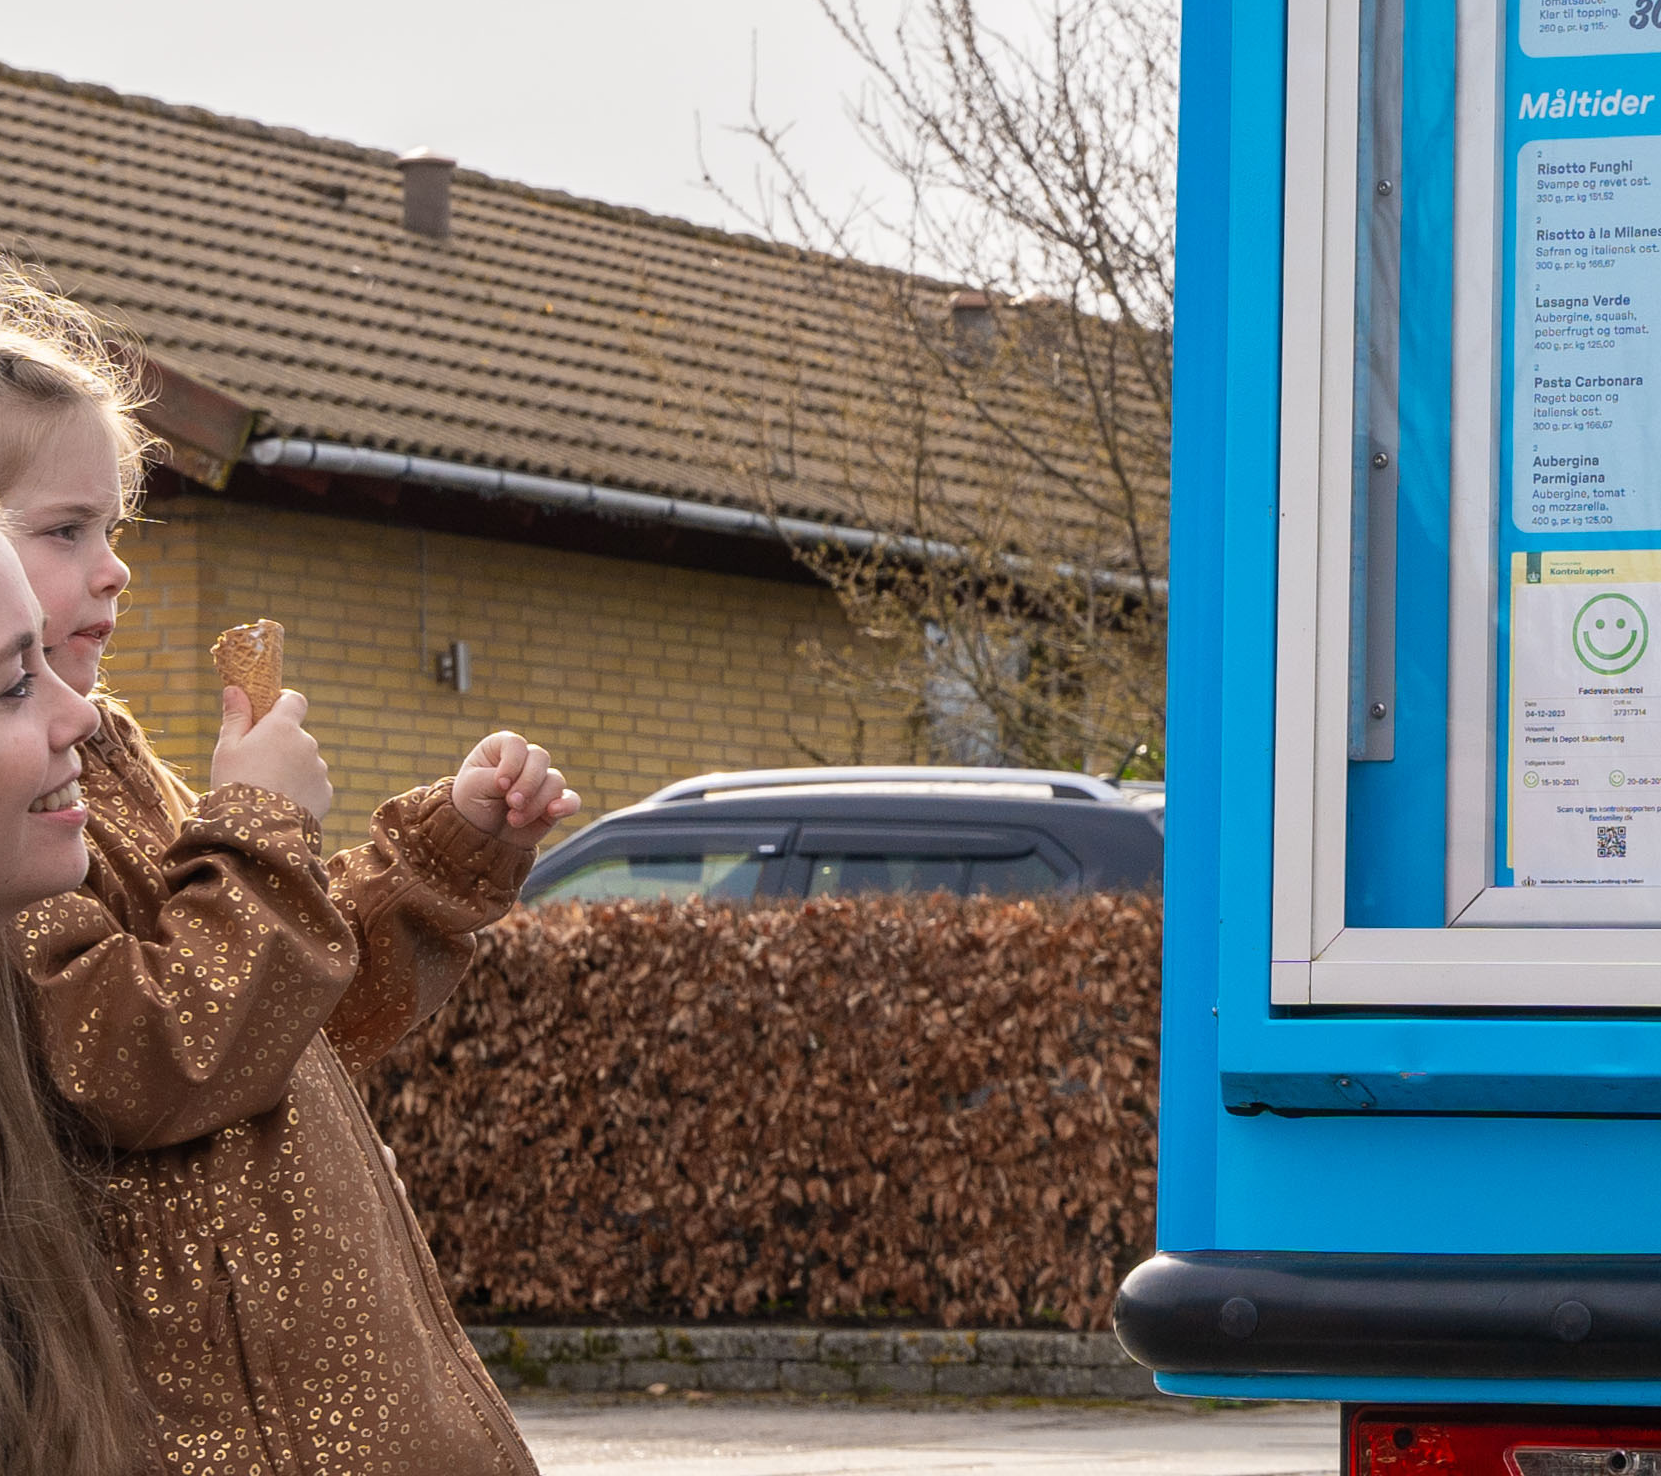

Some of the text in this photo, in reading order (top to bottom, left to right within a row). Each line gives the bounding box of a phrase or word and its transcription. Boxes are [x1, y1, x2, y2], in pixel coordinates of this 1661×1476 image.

[1519, 89, 1654, 119] Måltider
[1538, 160, 1632, 175] Risotto Funghi
